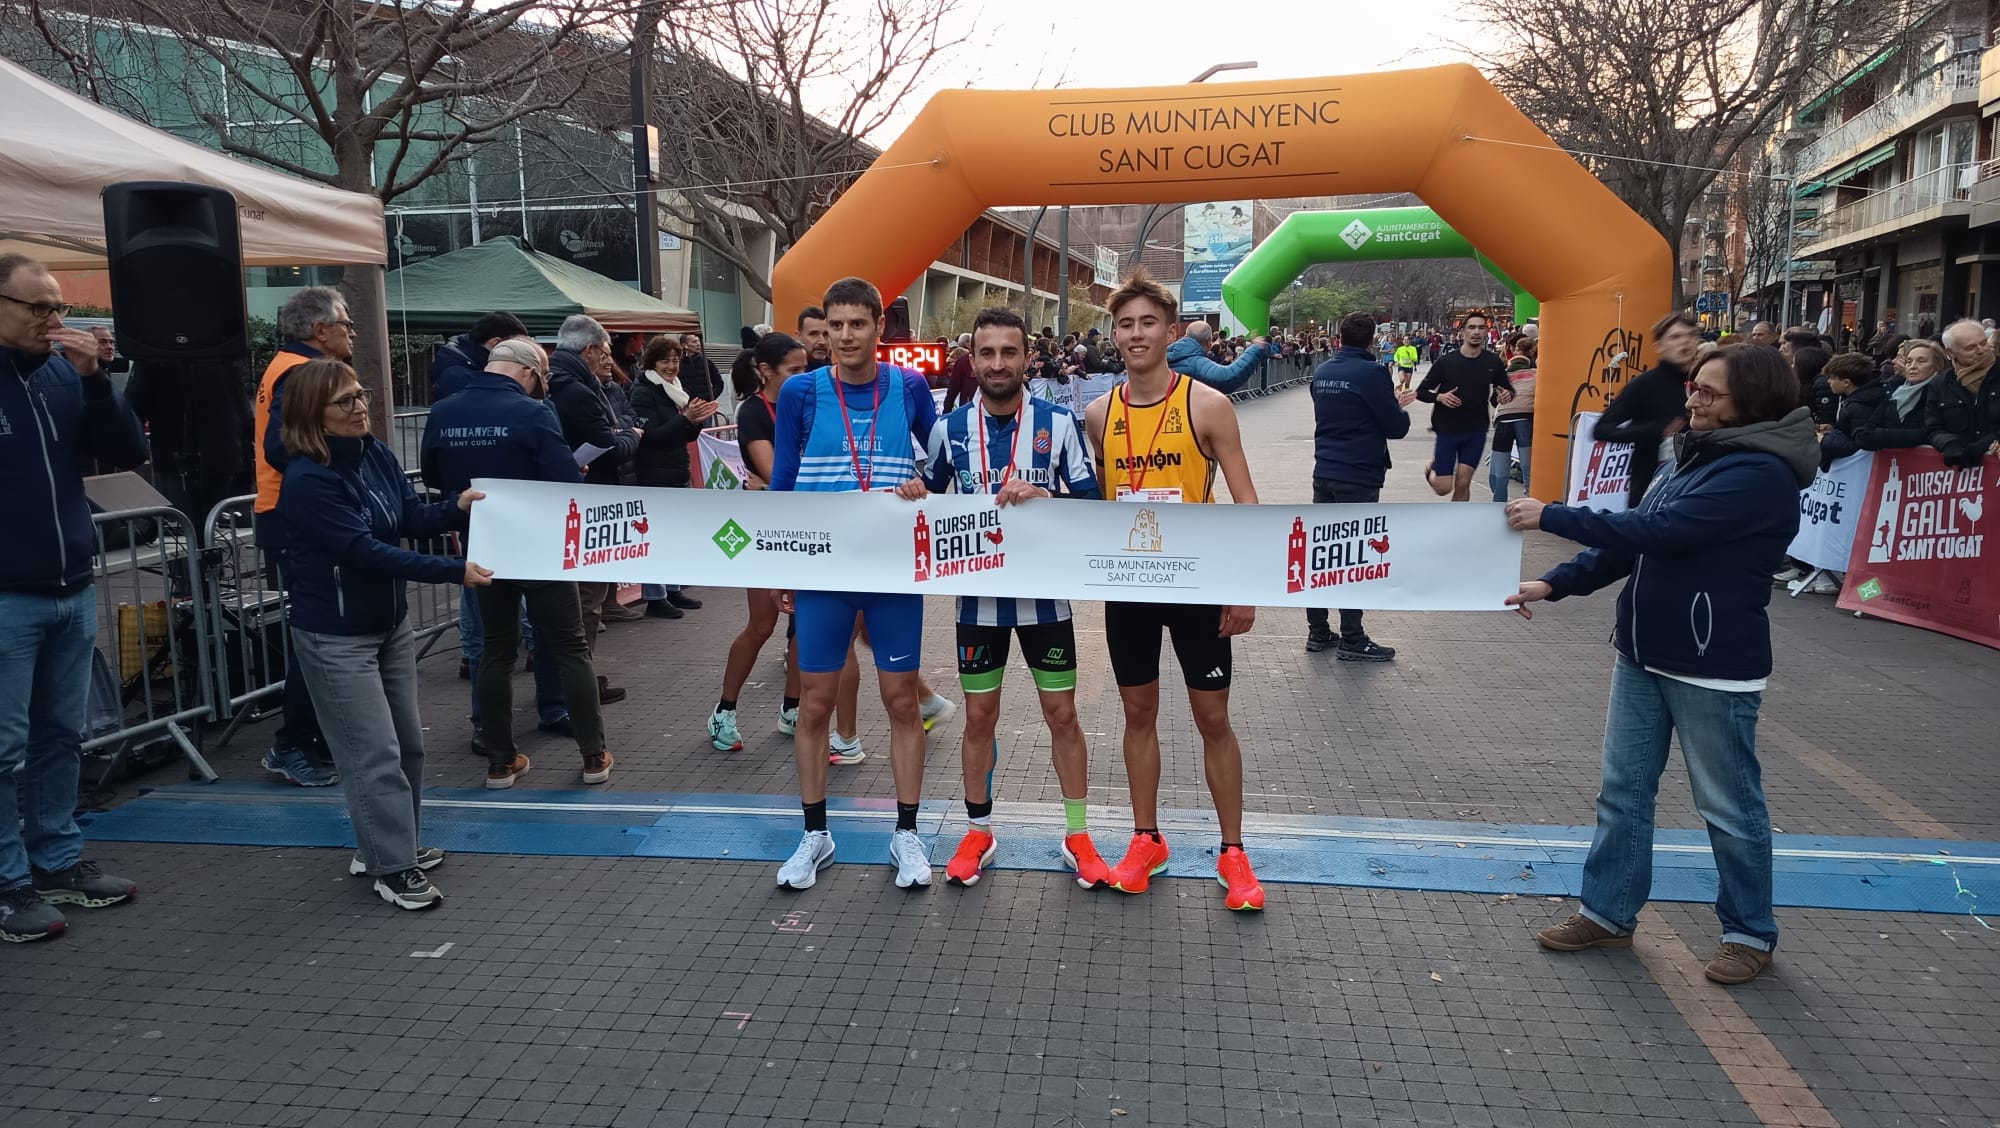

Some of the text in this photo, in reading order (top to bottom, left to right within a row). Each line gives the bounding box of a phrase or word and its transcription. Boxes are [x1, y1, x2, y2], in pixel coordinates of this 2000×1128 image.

[1048, 100, 1341, 137] CLUB MUNTANYENC
[1099, 141, 1286, 173] SANT CUGAT
[1375, 230, 1441, 243] SantCugat
[1376, 222, 1441, 232] AJUNTAMENT DE
[440, 426, 508, 438] MUNTANYENC
[1595, 478, 1624, 495] SANT
[1907, 465, 1984, 498] CURSA DEL
[585, 499, 647, 524] CURSA DEL
[934, 509, 1001, 536] CURSA DEL
[1901, 497, 1960, 537] GALL
[585, 521, 632, 549] GALL
[756, 529, 832, 541] AJUNTAMENT DE
[1313, 515, 1388, 543] CURSA DEL
[582, 542, 650, 566] SANT CUGAT
[755, 539, 832, 556] SantCugat
[935, 531, 986, 561] GALL
[1311, 539, 1369, 571] GALL
[1897, 534, 1984, 561] SANT CUGAT
[935, 552, 1006, 578] SANT CUGAT
[1088, 559, 1196, 572] CLUB MUNTANYENC
[1107, 572, 1176, 584] SANT CUGAT
[1310, 562, 1391, 589] SANT CUGAT
